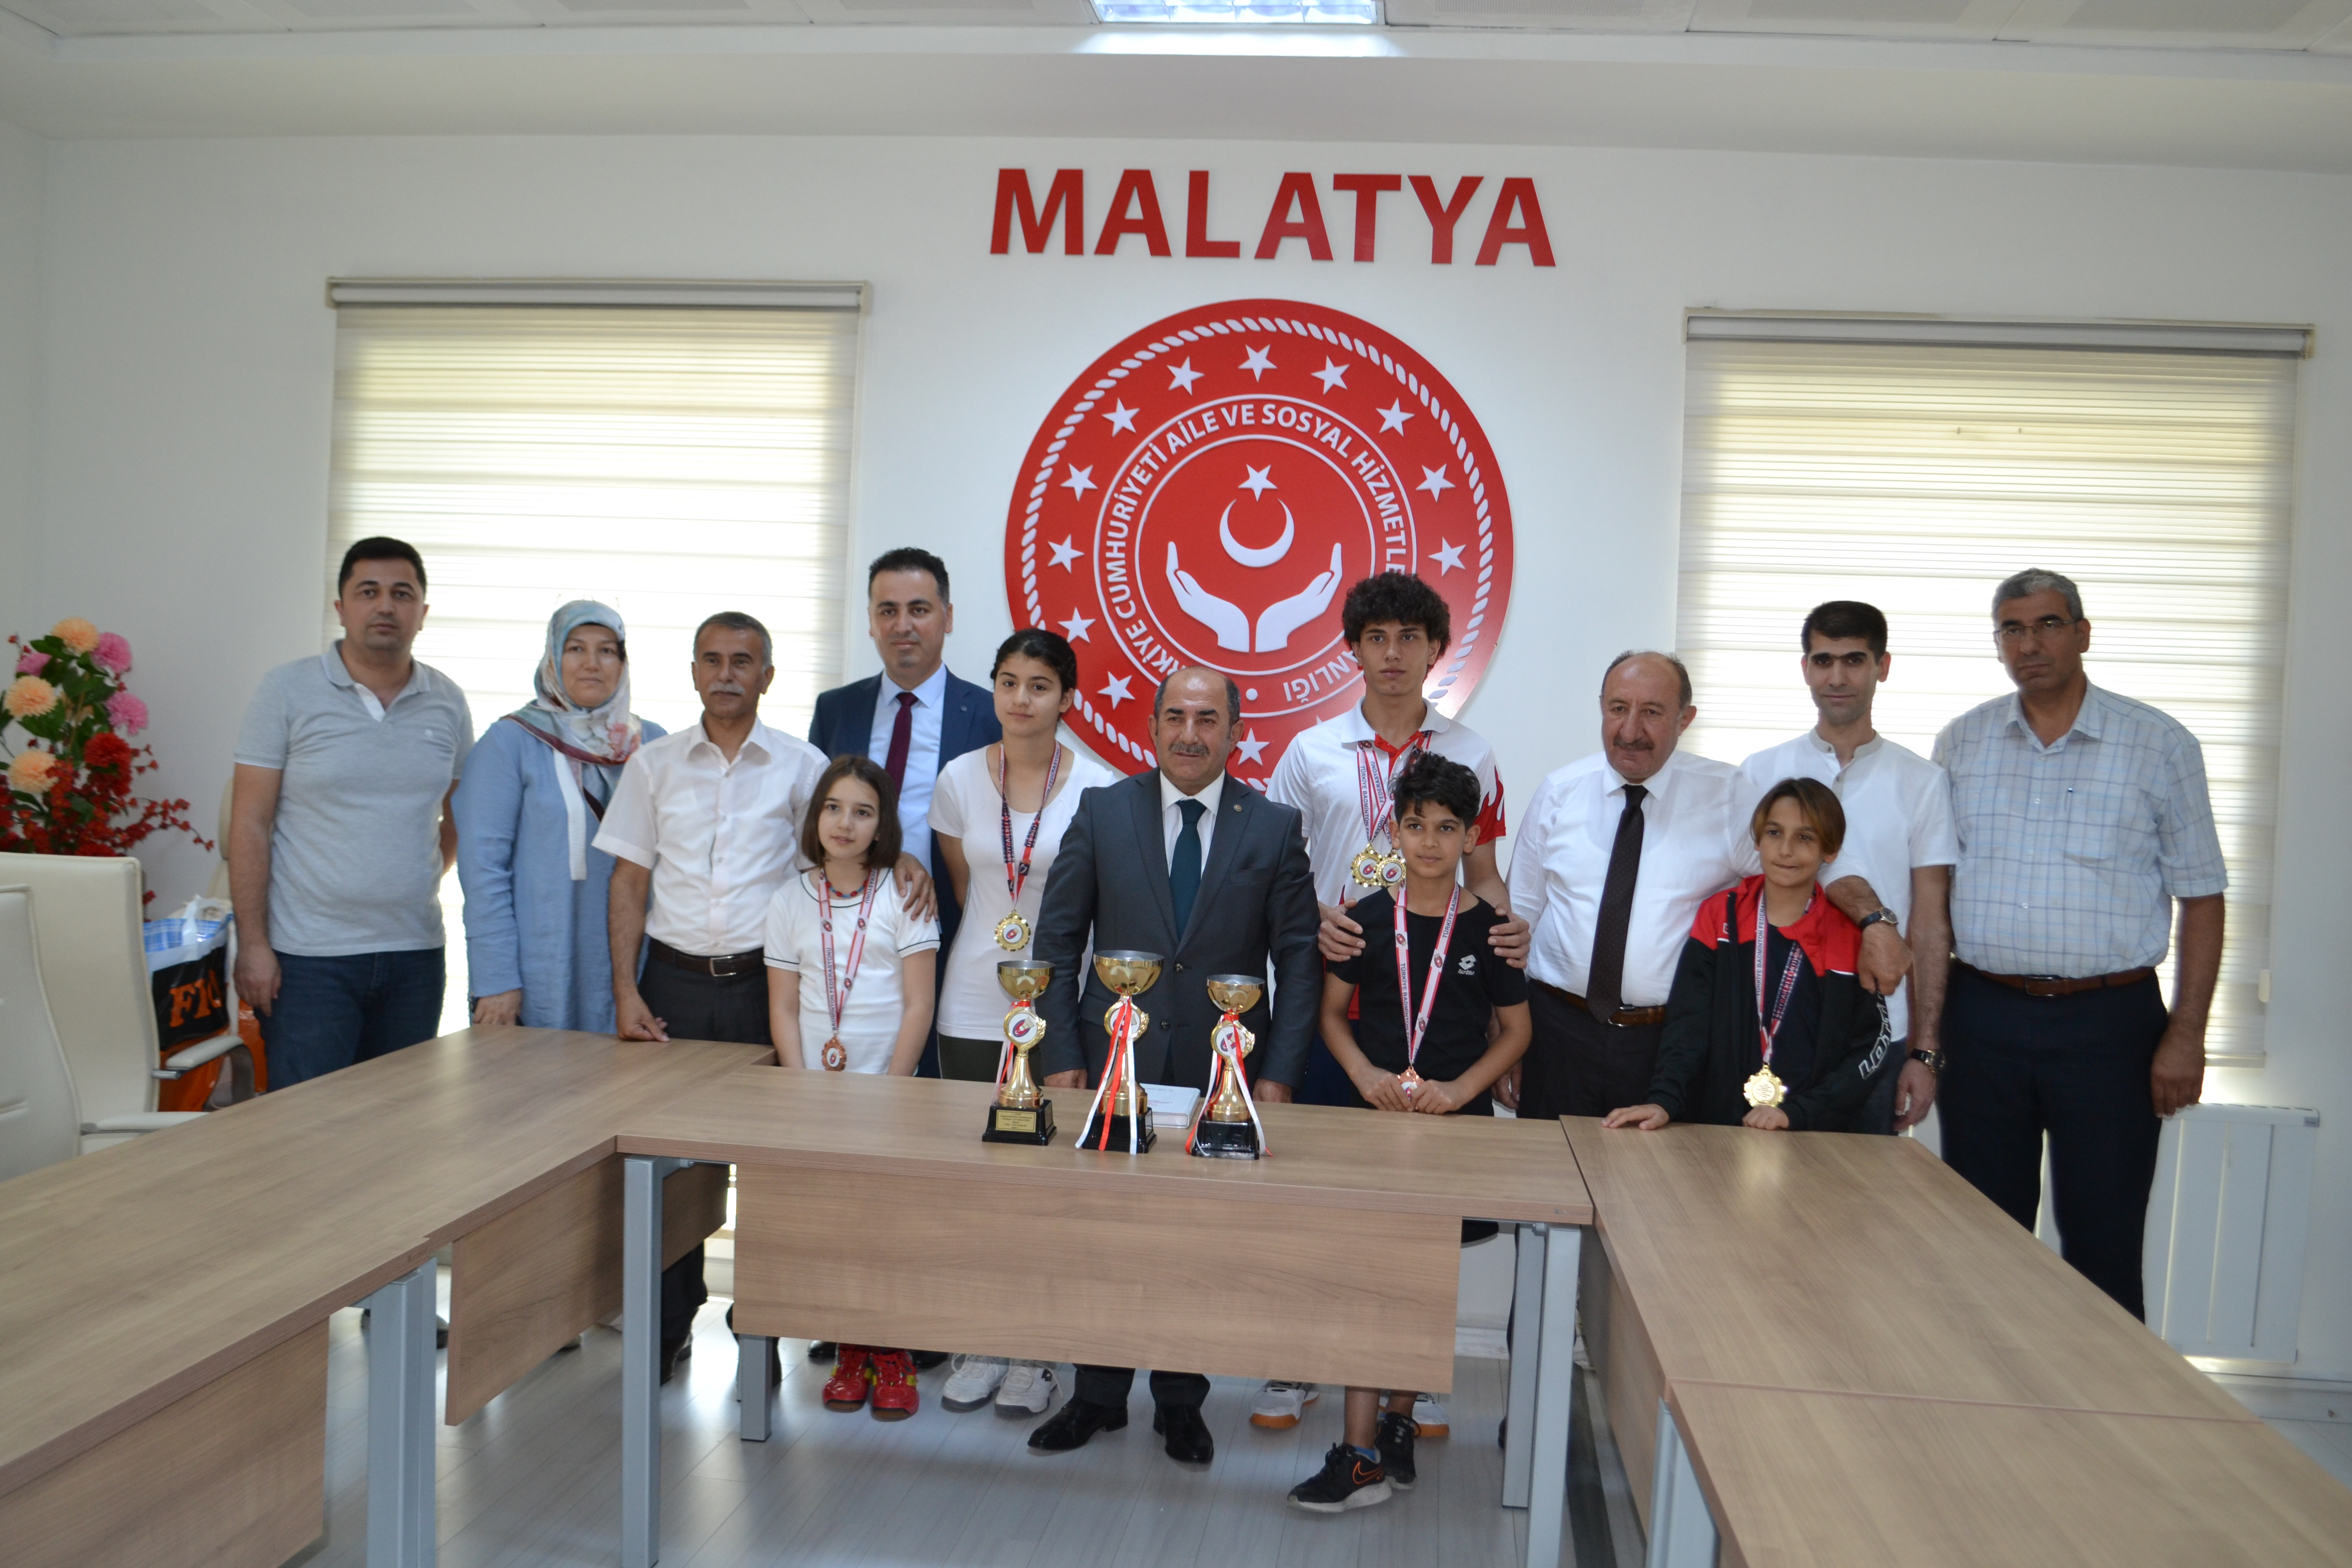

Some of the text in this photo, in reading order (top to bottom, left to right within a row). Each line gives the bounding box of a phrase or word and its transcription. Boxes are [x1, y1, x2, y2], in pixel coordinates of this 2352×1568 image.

[989, 167, 1556, 267] MALATYA
[1165, 410, 1220, 455] AİLE
[1220, 404, 1256, 427] VE
[1261, 403, 1353, 459] SOSYAL
[1105, 442, 1168, 619] CUMHURİYETİ
[1350, 450, 1407, 576] HİZMETLE
[1124, 618, 1187, 677] RKİYE
[1370, 761, 1384, 803] FEDERASYONU
[1442, 912, 1454, 939] TÜRKİYE
